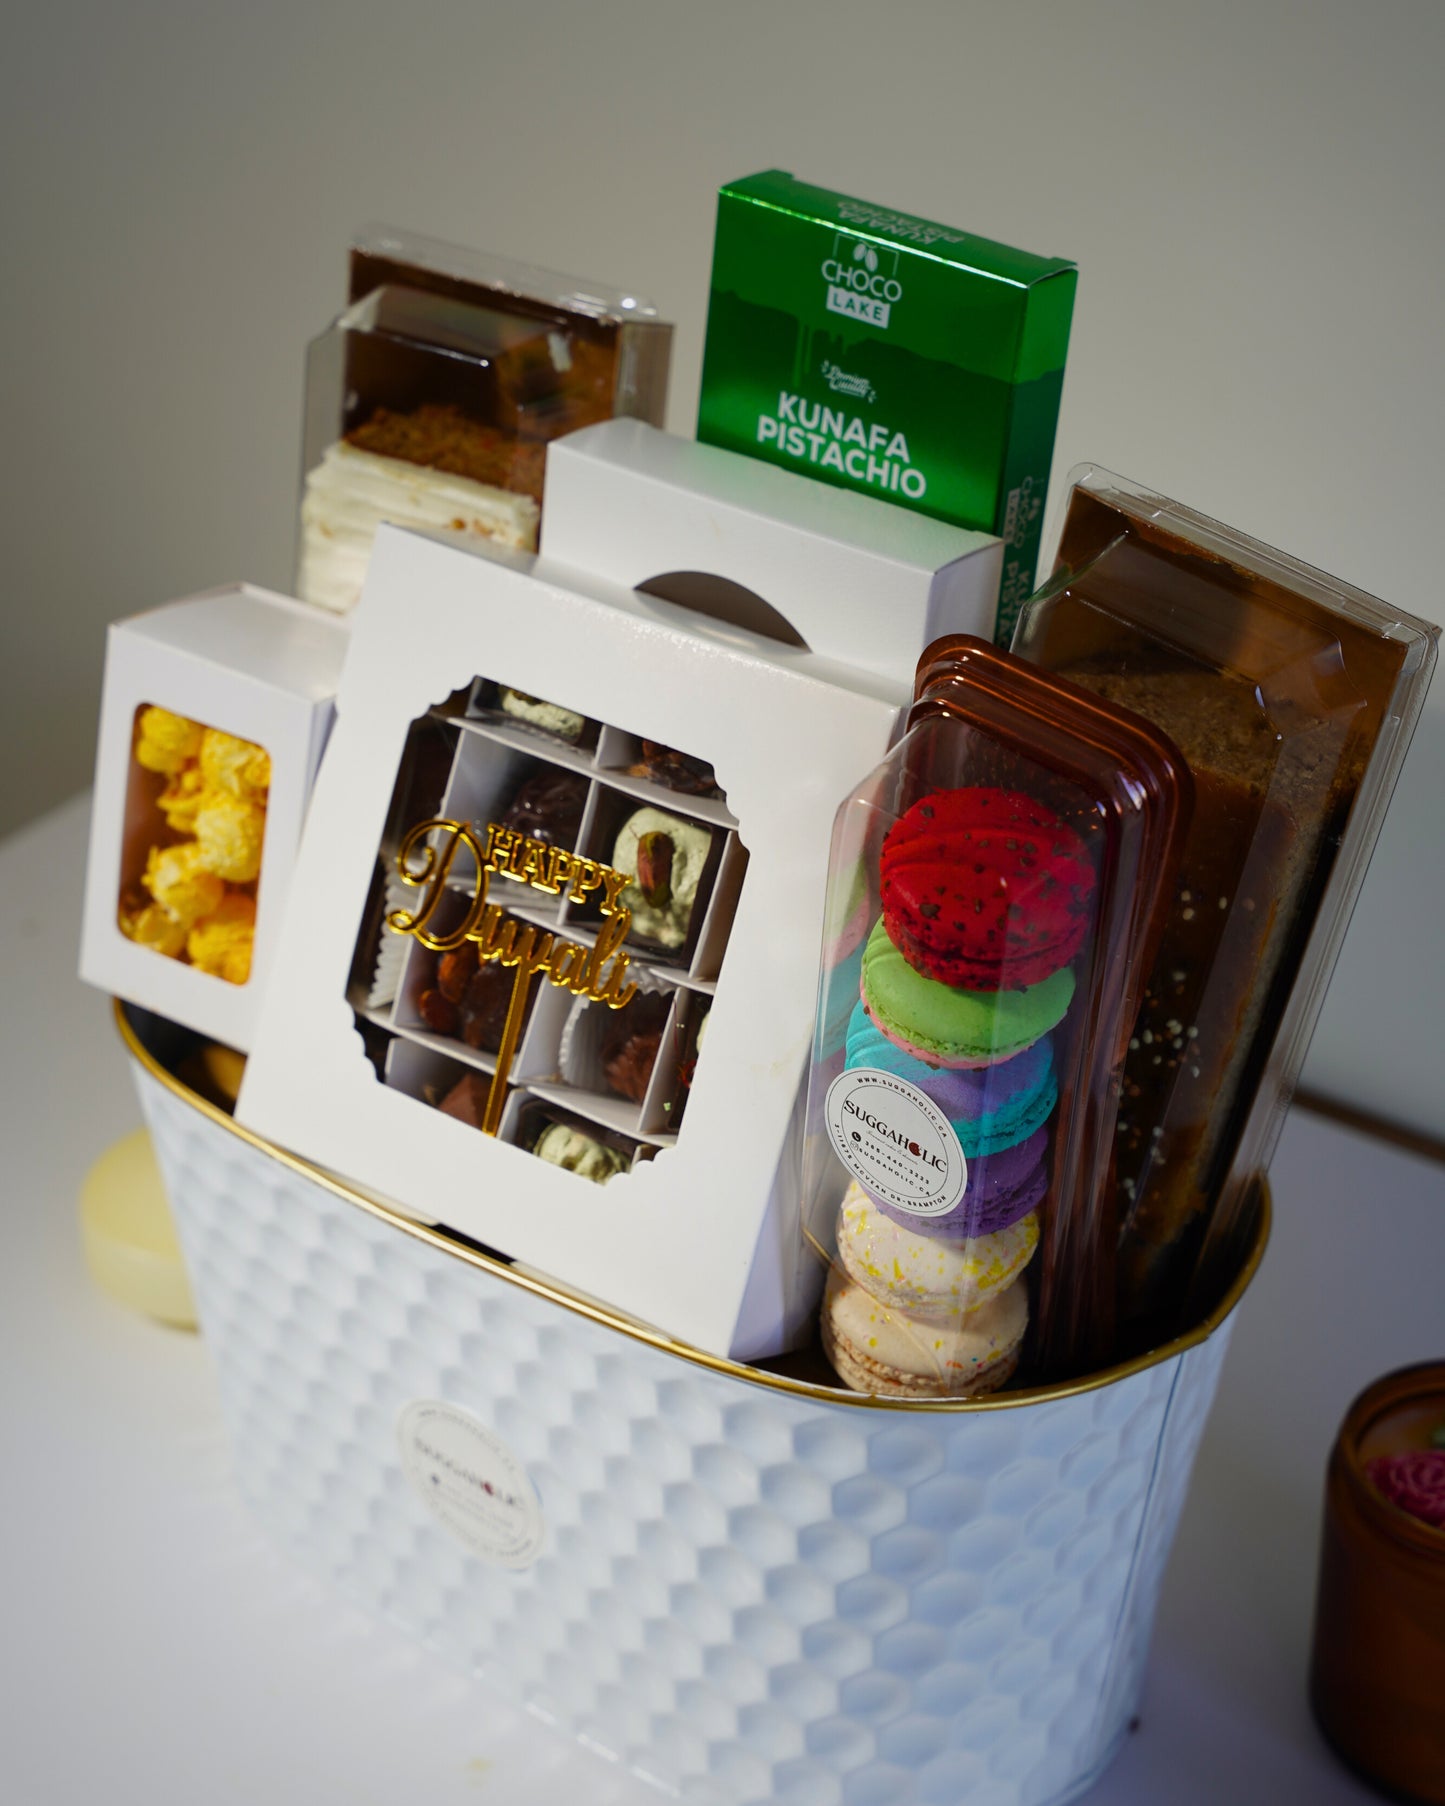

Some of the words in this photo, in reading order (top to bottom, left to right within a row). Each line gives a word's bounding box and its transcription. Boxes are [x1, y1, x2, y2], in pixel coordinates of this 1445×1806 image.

[821, 259, 902, 302] CHOCO
[832, 291, 884, 322] LAKE
[757, 415, 927, 499] PISTACHIO
[778, 390, 911, 464] KUNAFA
[483, 822, 634, 916] HAPPY
[386, 818, 638, 1010] Diwali
[843, 1100, 947, 1173] SUGGAHOLIC
[856, 1077, 948, 1138] WWW.SUGGAHOLIC.CA
